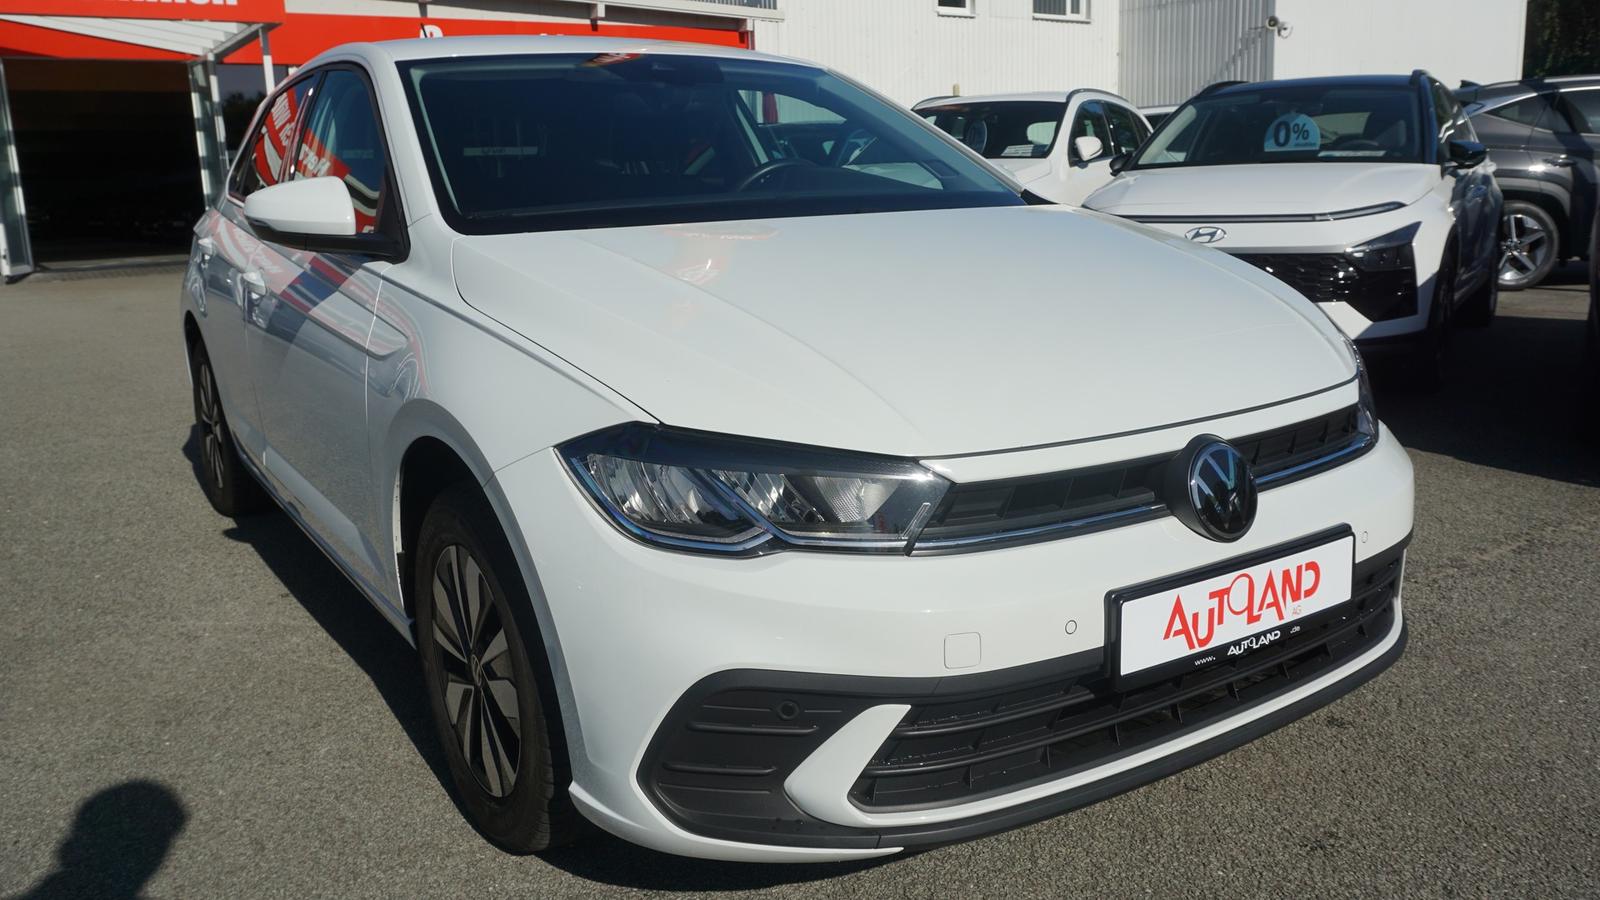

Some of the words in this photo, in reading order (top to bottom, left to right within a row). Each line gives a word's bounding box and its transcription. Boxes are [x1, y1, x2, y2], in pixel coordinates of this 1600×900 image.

[1273, 120, 1310, 147] 0%
[1163, 561, 1320, 650] AUTOLAND
[1226, 630, 1281, 656] AUTOLAND
